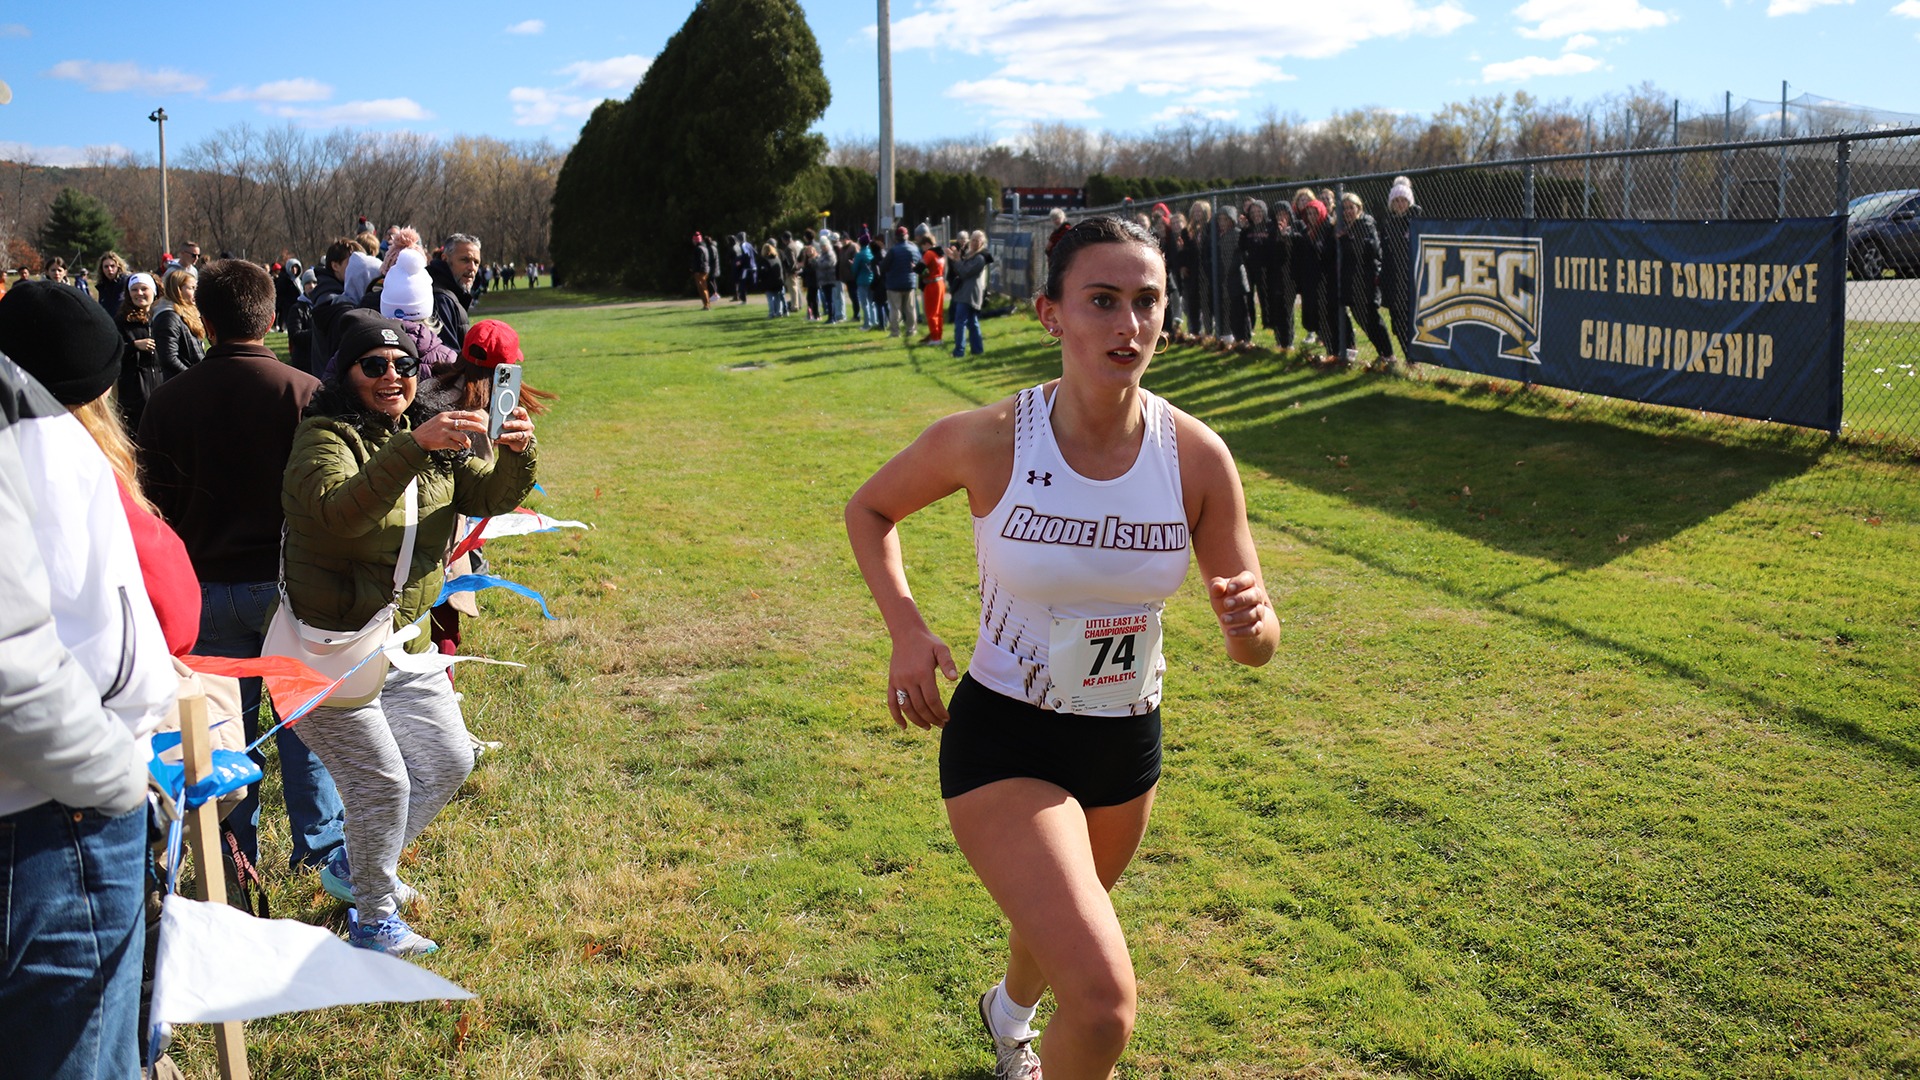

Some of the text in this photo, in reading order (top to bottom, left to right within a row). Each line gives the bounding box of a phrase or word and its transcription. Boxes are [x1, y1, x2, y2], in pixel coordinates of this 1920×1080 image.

[1418, 247, 1535, 325] LEC
[1554, 256, 1818, 303] LITTLE EAST CONFERENCE
[1580, 319, 1774, 380] CHAMPIONSHIP
[1000, 505, 1187, 552] RHODE ISLAND
[1084, 624, 1147, 639] CHAMPIONSHIPS
[1086, 614, 1148, 629] LITTLE EAST X-C
[1089, 634, 1136, 676] 74
[1082, 677, 1096, 687] MF
[1096, 671, 1137, 685] ATHLETIC
